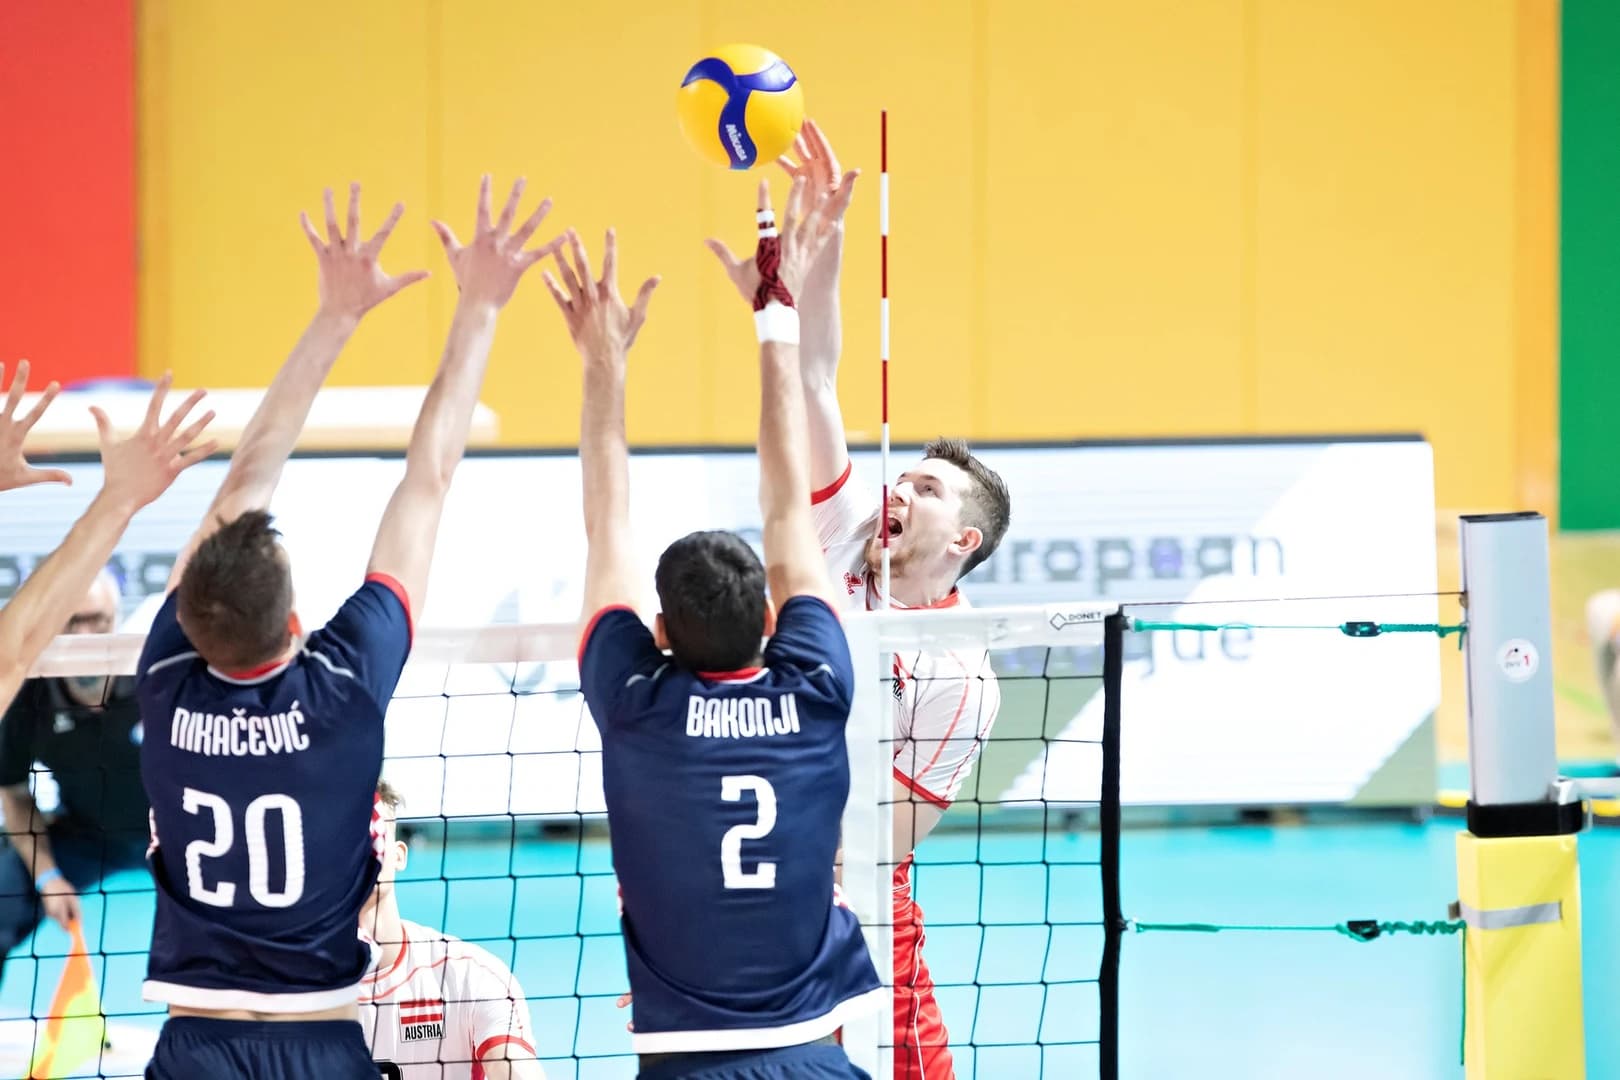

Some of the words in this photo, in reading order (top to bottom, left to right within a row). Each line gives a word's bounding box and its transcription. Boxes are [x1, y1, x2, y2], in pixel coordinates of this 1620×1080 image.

[170, 699, 310, 757] NIKAČEVIĆ
[685, 693, 801, 739] BAKONJI
[182, 786, 306, 908] 20
[720, 774, 777, 889] 2
[404, 1023, 443, 1041] AUSTRIA
